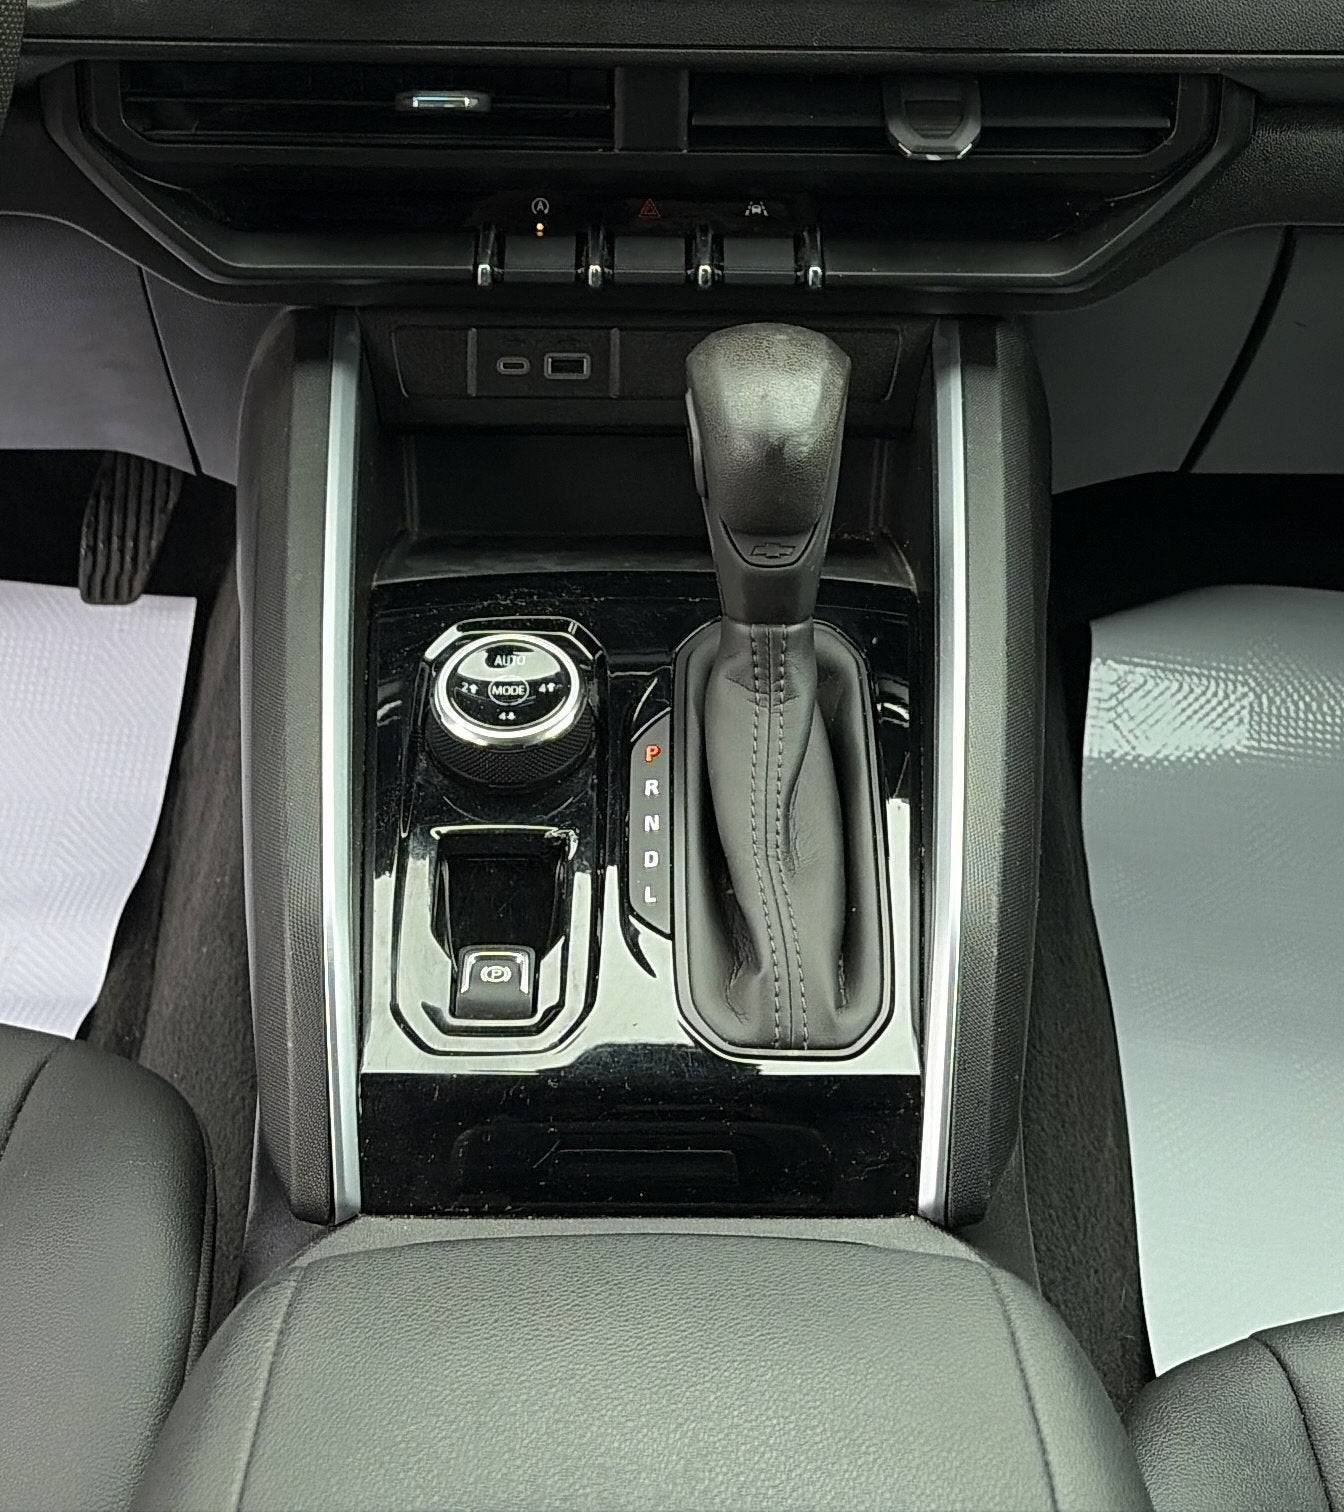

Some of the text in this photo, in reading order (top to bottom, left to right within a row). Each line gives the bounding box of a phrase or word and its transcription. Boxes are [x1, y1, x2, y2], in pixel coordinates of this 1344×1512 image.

[494, 654, 527, 667] AUTO
[492, 685, 525, 696] MODE
[645, 745, 661, 762] P
[645, 779, 659, 796] R
[645, 814, 660, 831] N
[645, 850, 658, 867] D
[645, 886, 657, 903] L
